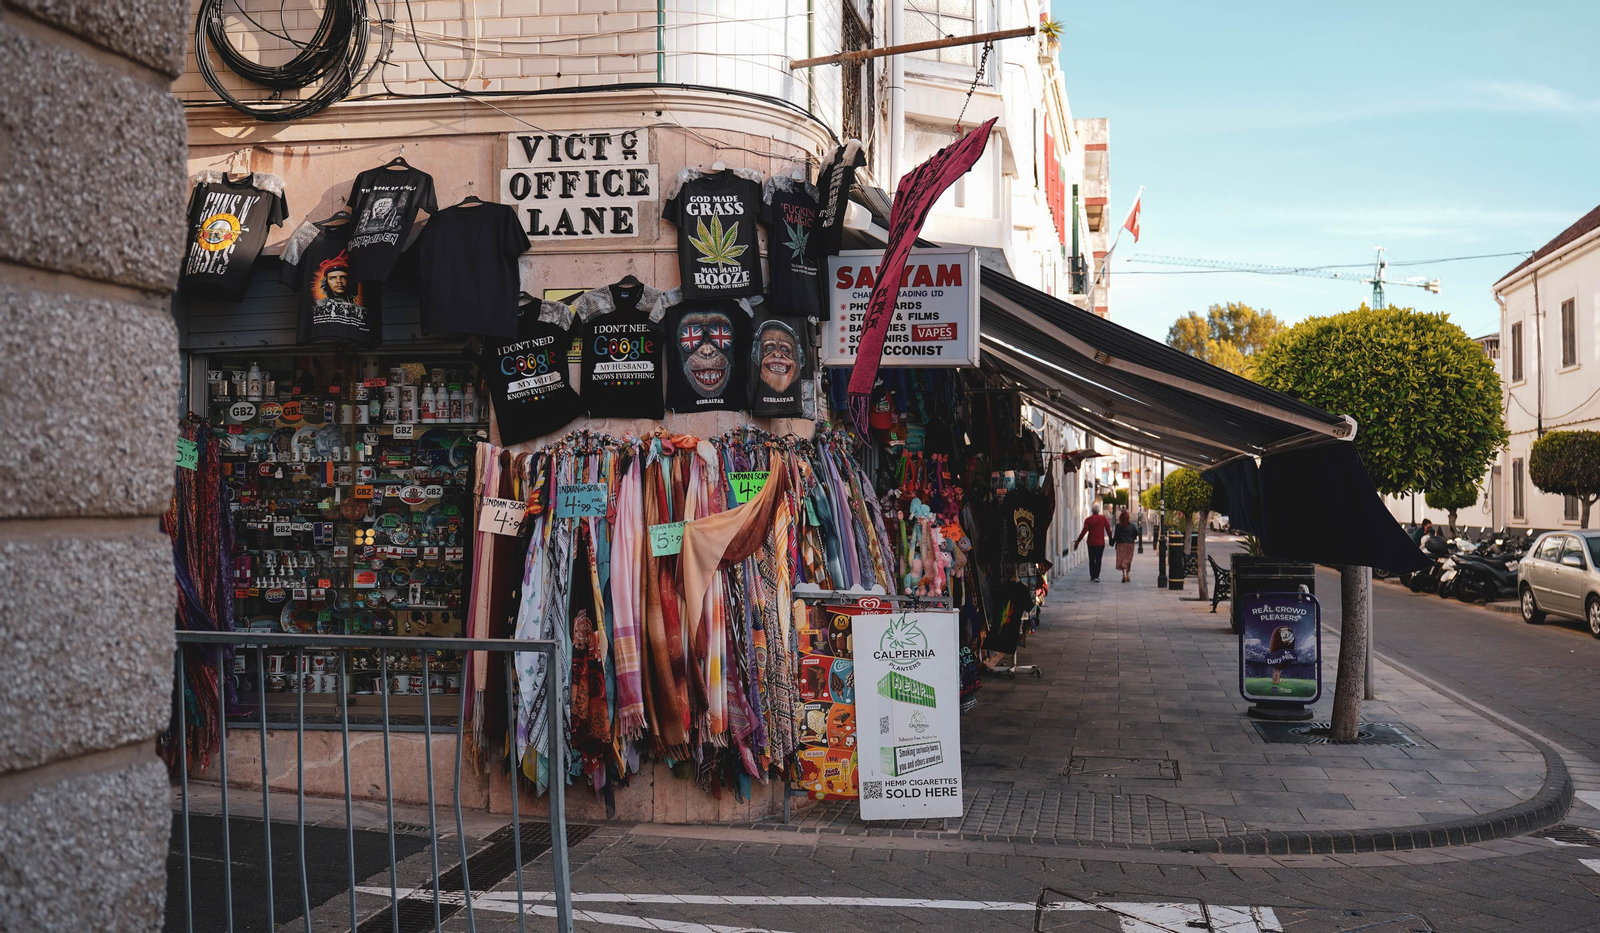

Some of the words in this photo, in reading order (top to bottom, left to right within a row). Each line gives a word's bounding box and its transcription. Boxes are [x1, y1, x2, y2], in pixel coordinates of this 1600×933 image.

[509, 168, 650, 200] OFFICE
[689, 195, 711, 203] GOD
[712, 195, 739, 203] MADE
[686, 202, 745, 216] GRASS
[526, 205, 634, 237] LANE
[785, 213, 814, 228] MAGIC
[693, 270, 751, 285] BOOZE
[836, 264, 962, 290] SAYAM
[891, 290, 928, 298] RADING
[896, 312, 903, 321] &
[908, 312, 940, 321] FILMS
[594, 326, 598, 334] I
[599, 324, 628, 334] DON'T
[628, 324, 651, 332] NEE
[917, 327, 952, 338] VAPES
[497, 348, 502, 356] I
[502, 340, 531, 354] DON'T
[532, 336, 555, 348] NEED
[594, 335, 654, 360] Google
[500, 348, 557, 376] Google
[612, 362, 648, 370] HUSBAND
[518, 380, 533, 389] MY
[534, 374, 554, 385] WIFE
[506, 390, 531, 401] KNOWS
[530, 382, 565, 396] EVERYTHING
[232, 406, 254, 416] GBZ
[260, 407, 280, 416] GBZ
[484, 498, 507, 508] INDIAN
[565, 496, 592, 514] 4:99
[1252, 606, 1274, 614] REAL
[1275, 606, 1307, 615] CROWD
[873, 649, 936, 660] CALPERNIA
[888, 660, 922, 672] PLANTERS
[898, 748, 916, 758] Smoking
[916, 746, 930, 754] seriously
[898, 764, 907, 774] you
[906, 760, 914, 770] and
[914, 758, 926, 767] others
[926, 754, 936, 764] around
[908, 778, 958, 786] CIGARETTES
[886, 788, 922, 799] SOLD
[925, 786, 958, 798] HERE
